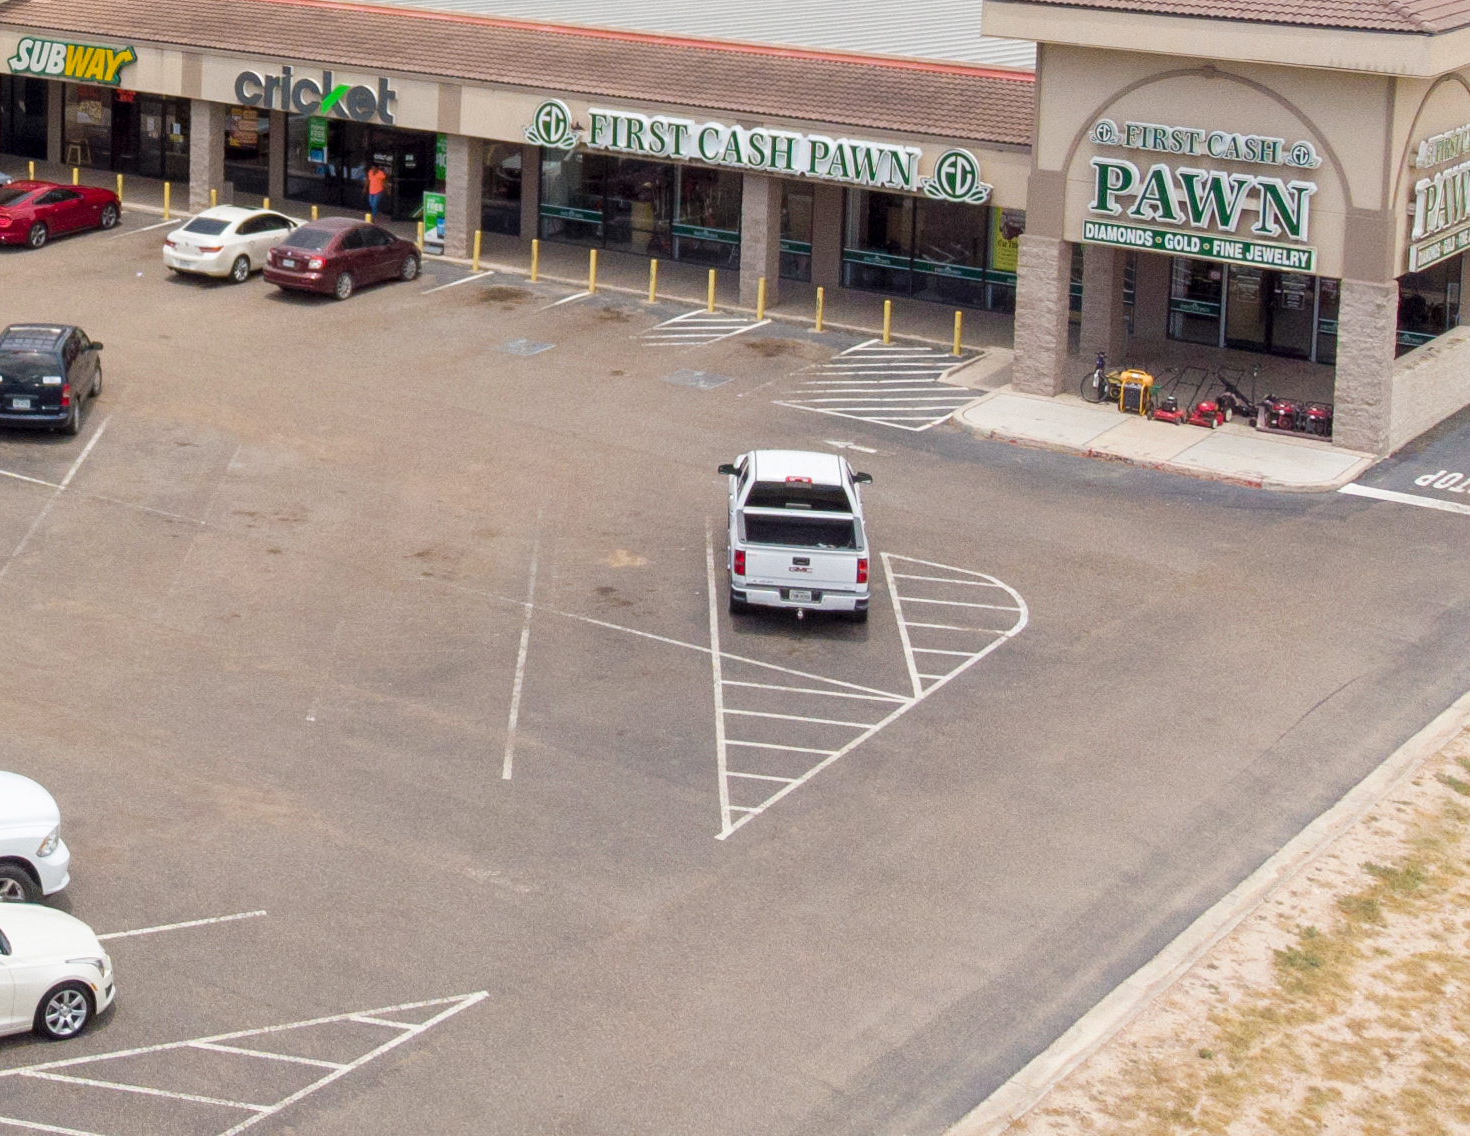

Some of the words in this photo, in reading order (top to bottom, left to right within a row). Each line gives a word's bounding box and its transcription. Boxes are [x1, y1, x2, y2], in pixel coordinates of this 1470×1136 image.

[9, 39, 133, 81] SUBWAY
[235, 65, 398, 125] cricket
[588, 111, 691, 157] FIRST
[697, 125, 798, 173] CASH
[807, 139, 916, 188] PAWN
[1124, 123, 1200, 155] FIRST
[1206, 133, 1280, 164] CASH
[1089, 160, 1315, 240] PAWN
[1085, 223, 1153, 247] DIAMONDS
[1164, 234, 1201, 253] GOLD
[1213, 240, 1243, 259] FINE
[1246, 245, 1309, 268] JEWELRY
[1414, 470, 1470, 494] TOP
